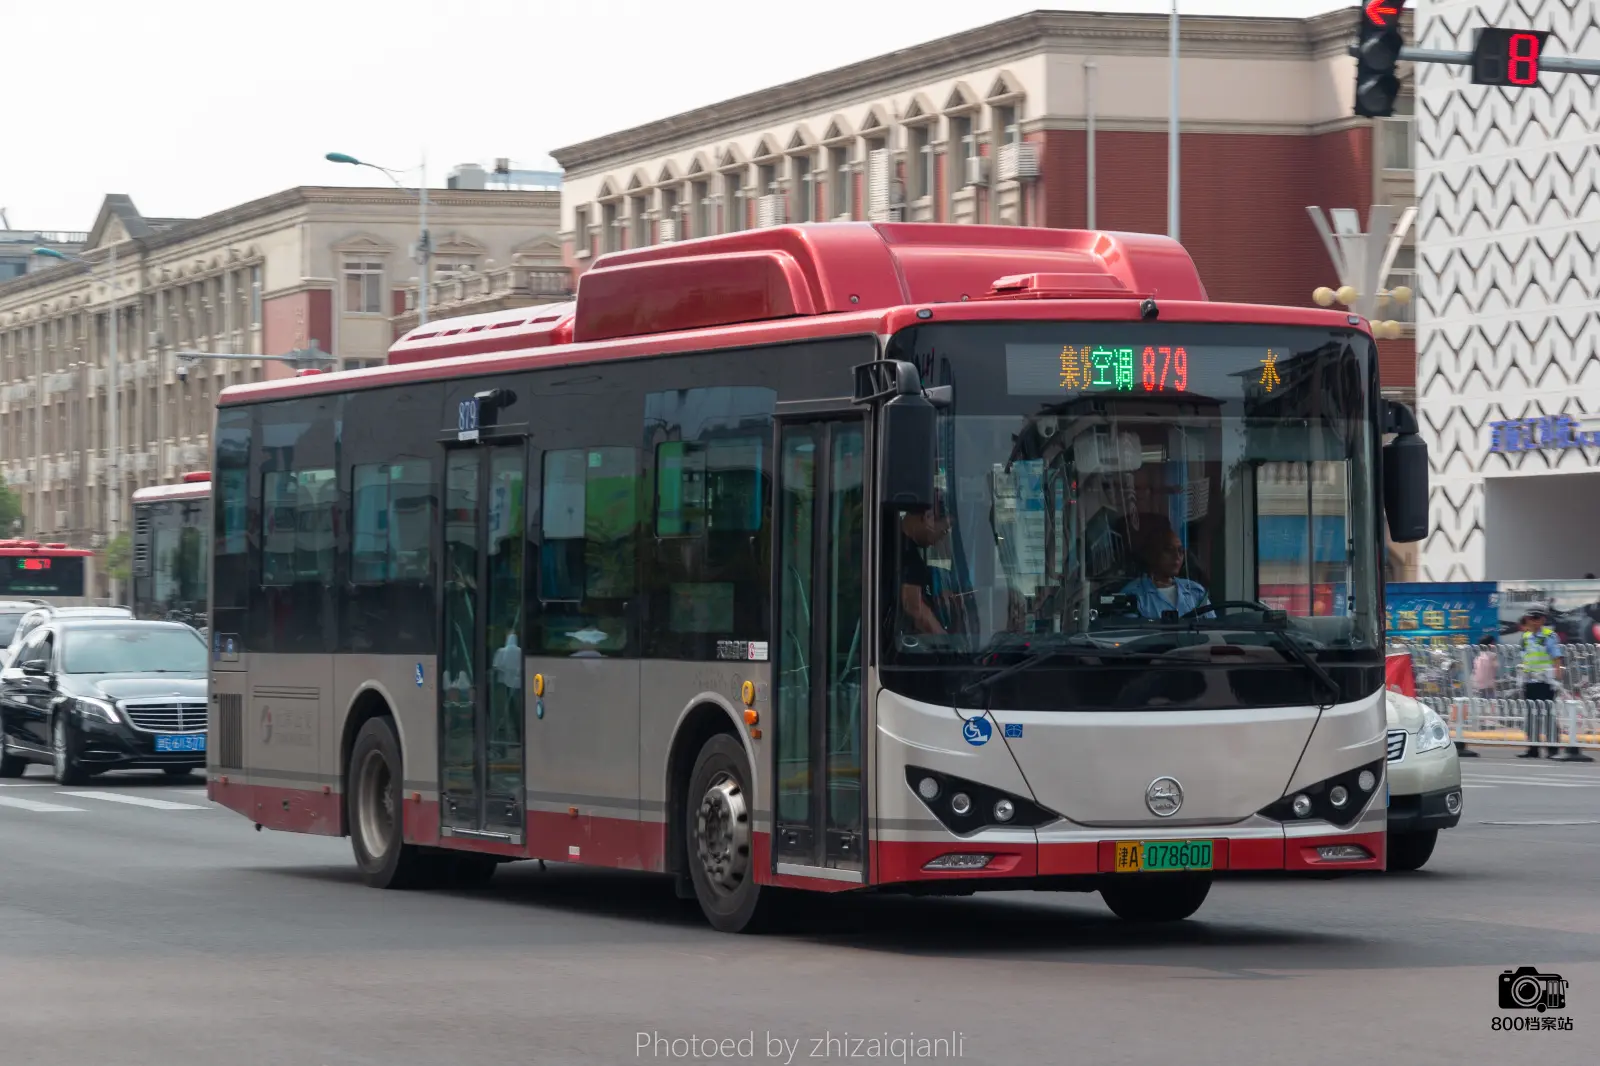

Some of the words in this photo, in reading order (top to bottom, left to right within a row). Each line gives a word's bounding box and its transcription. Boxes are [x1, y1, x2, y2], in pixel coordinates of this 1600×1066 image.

[1507, 33, 1540, 85] 8
[1091, 345, 1133, 391] 空调
[1142, 346, 1187, 392] 879
[458, 400, 477, 431] 879
[1118, 846, 1139, 868] 津A
[1147, 845, 1211, 867] 07860D
